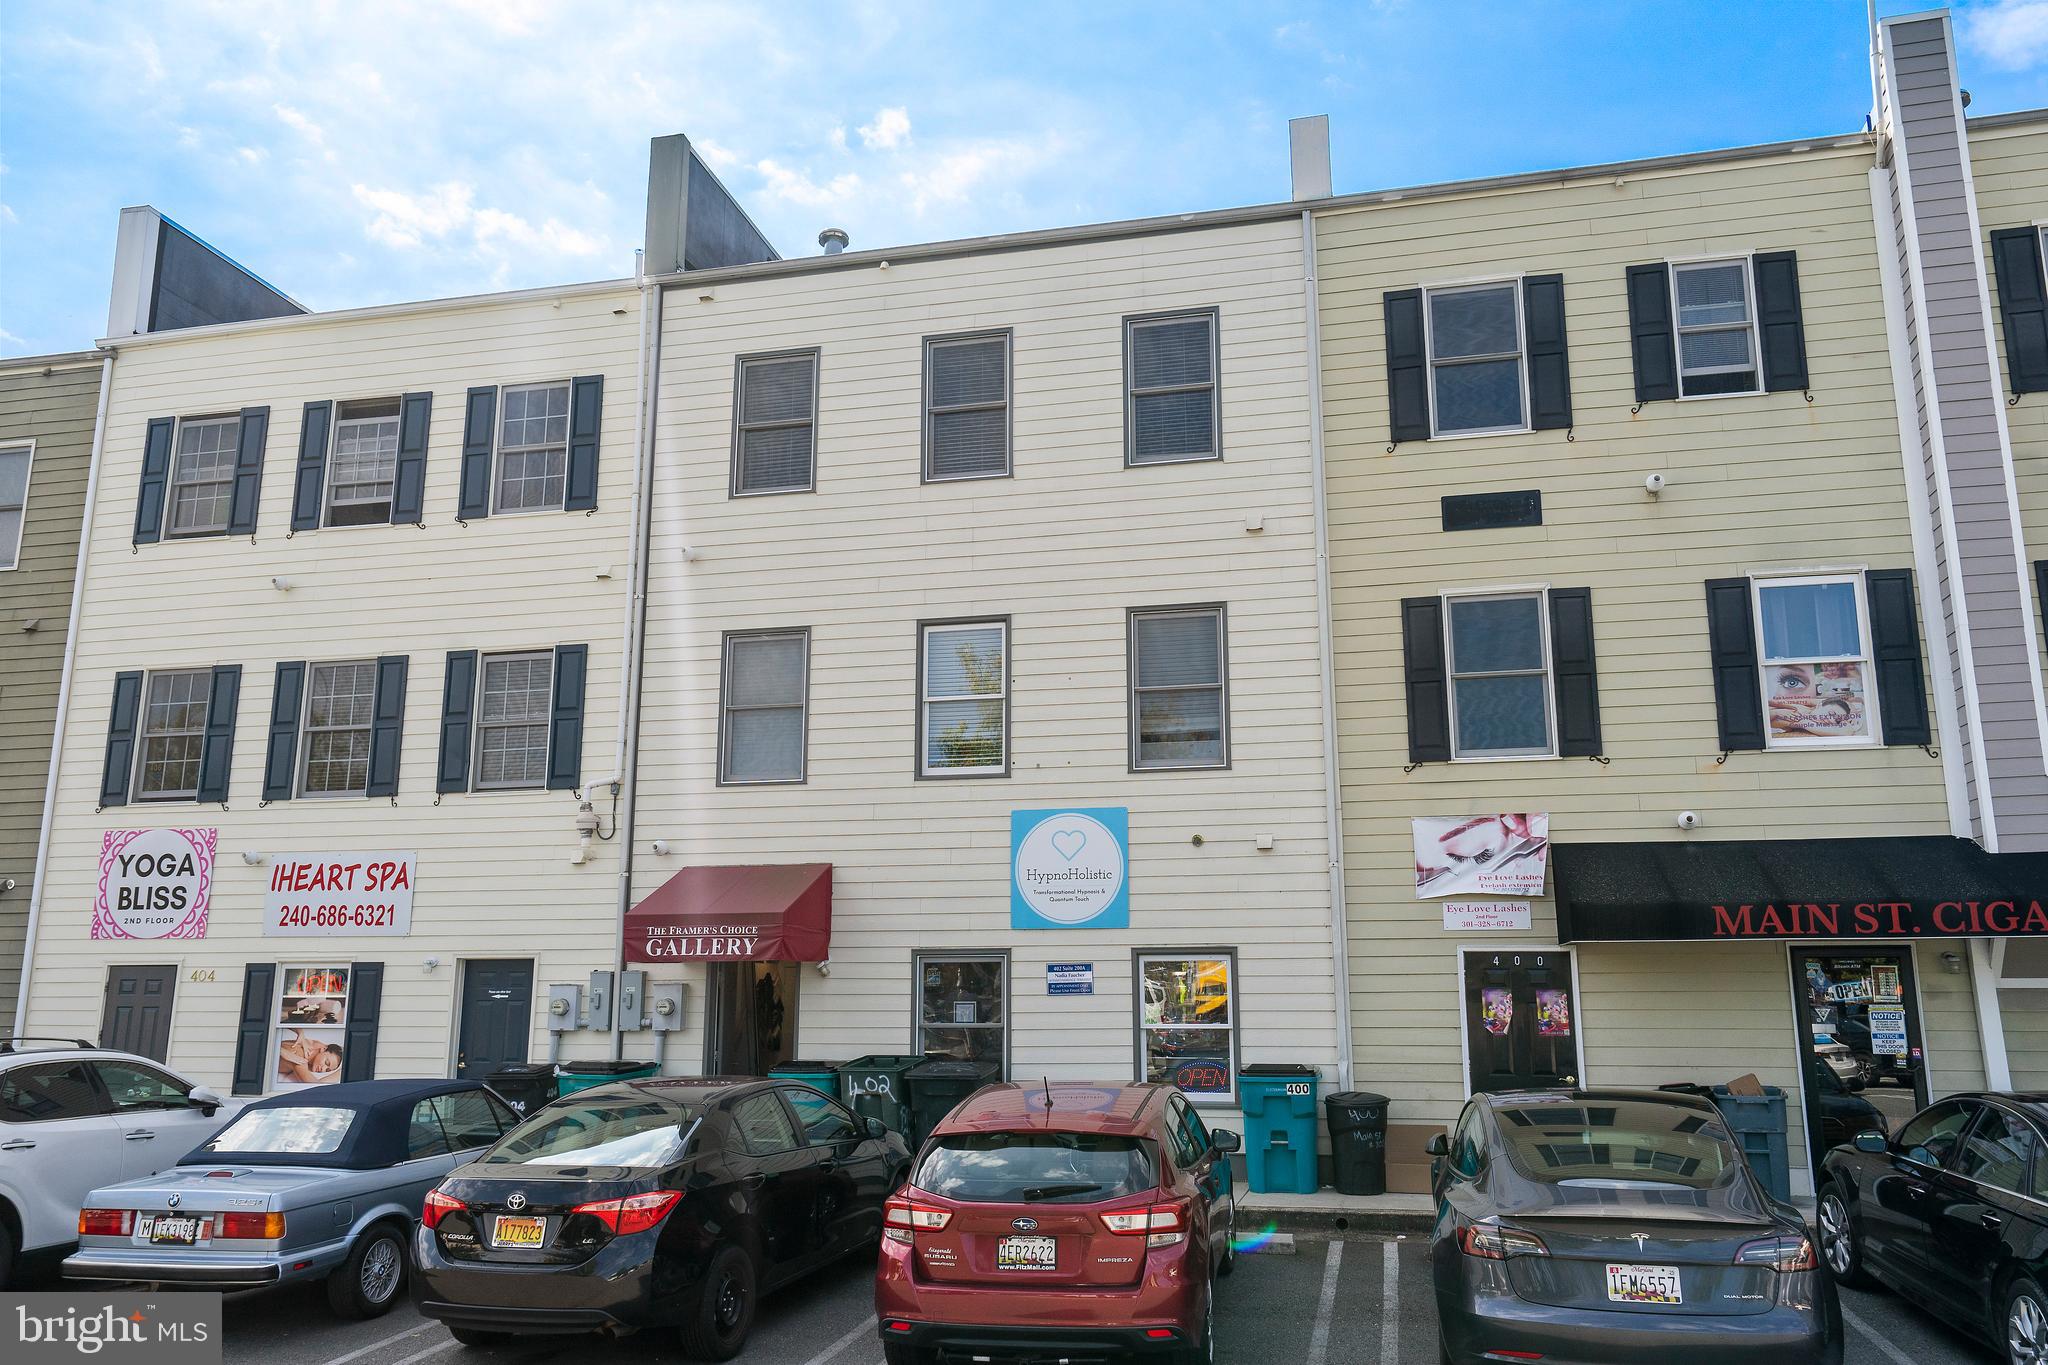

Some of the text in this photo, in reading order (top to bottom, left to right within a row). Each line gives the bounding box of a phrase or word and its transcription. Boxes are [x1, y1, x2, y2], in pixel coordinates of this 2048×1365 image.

[118, 853, 195, 877] YOGA
[271, 862, 409, 892] IHEART SPA
[1026, 867, 1113, 884] HypnoHolistic
[117, 886, 187, 911] BLISS
[279, 904, 395, 927] 240-686-6321
[1447, 903, 1527, 914] Eye Love Lashes
[1712, 899, 2048, 935] MAIN ST. CIGA
[669, 925, 718, 935] FRAMER'S
[720, 925, 758, 935] CHOICE
[645, 938, 758, 956] GALLERY
[190, 969, 216, 983] 404
[297, 975, 343, 993] OPEN
[1834, 980, 1873, 999] OPEN
[1176, 1068, 1229, 1087] OPEN
[849, 1075, 897, 1110] 402
[1287, 1084, 1309, 1094] 400
[447, 1233, 474, 1241] COROLLA
[496, 1223, 543, 1241] A177823
[999, 1244, 1054, 1262] 4ER2622
[1612, 1274, 1676, 1294] 1FM6557
